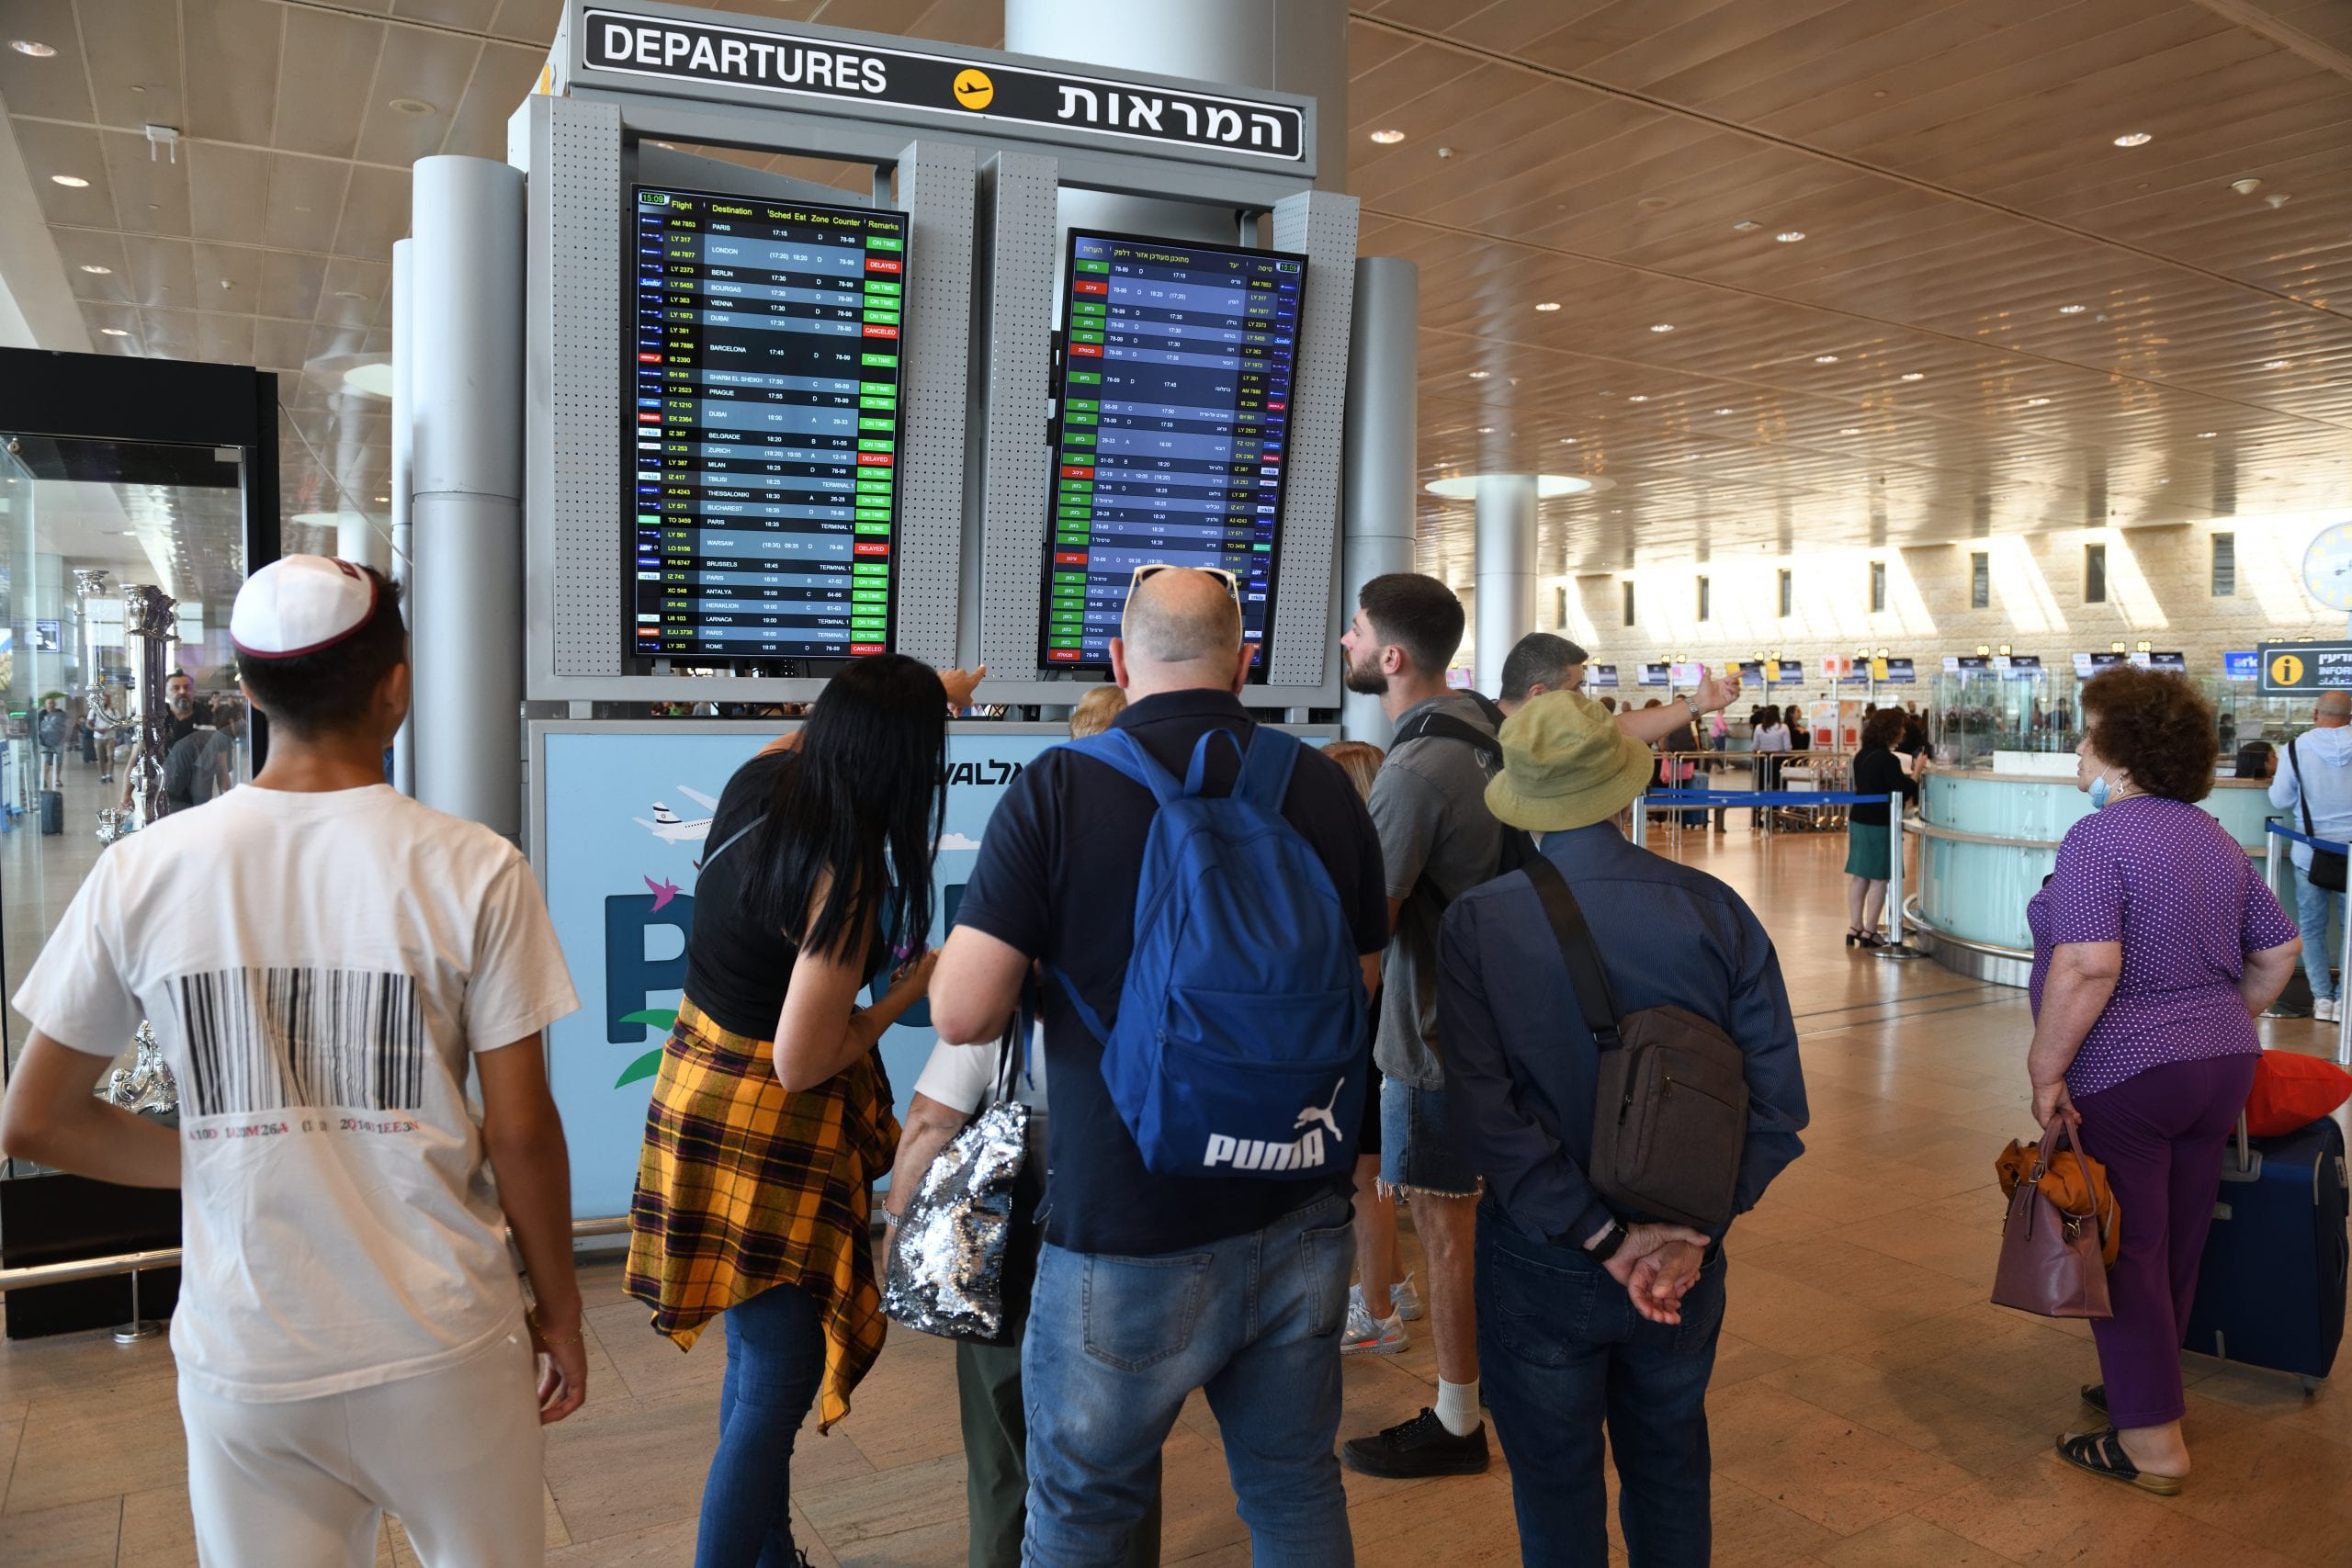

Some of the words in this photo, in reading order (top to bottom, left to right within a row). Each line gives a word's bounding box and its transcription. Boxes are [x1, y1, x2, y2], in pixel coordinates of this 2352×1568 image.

[603, 24, 888, 95] DEPARTURES
[1057, 84, 1283, 148] המראות
[641, 192, 663, 203] 15:09
[671, 199, 692, 211] Flight
[711, 203, 752, 216] Destination
[768, 209, 792, 220] Sched
[794, 212, 807, 221] Est
[810, 213, 830, 223] Zone
[832, 216, 861, 227] Counter
[867, 220, 899, 231] Remarks
[711, 222, 730, 231] PARIS
[1113, 247, 1130, 258] דלפק
[711, 245, 738, 255] LONDON
[869, 261, 897, 270] DELAYED
[1227, 261, 1239, 269] יעד
[1280, 263, 1297, 272] 15:09
[710, 268, 733, 277] BERLIN
[709, 299, 733, 308] VIENNA
[709, 314, 729, 322] DUBAI
[864, 326, 896, 335] CANCELED
[709, 344, 746, 353] BARCELONA
[708, 388, 734, 396] PRAGUE
[707, 410, 727, 418] DUBAI
[707, 432, 741, 440] BELGRADE
[861, 455, 888, 463] DELAYED
[707, 460, 726, 468] MILAN
[707, 490, 750, 498] THESSALONIKI
[2233, 656, 2258, 668] ark
[2318, 653, 2352, 665] ודיעין
[2318, 666, 2352, 675] INFOR
[1203, 1127, 1326, 1171] PUMA
